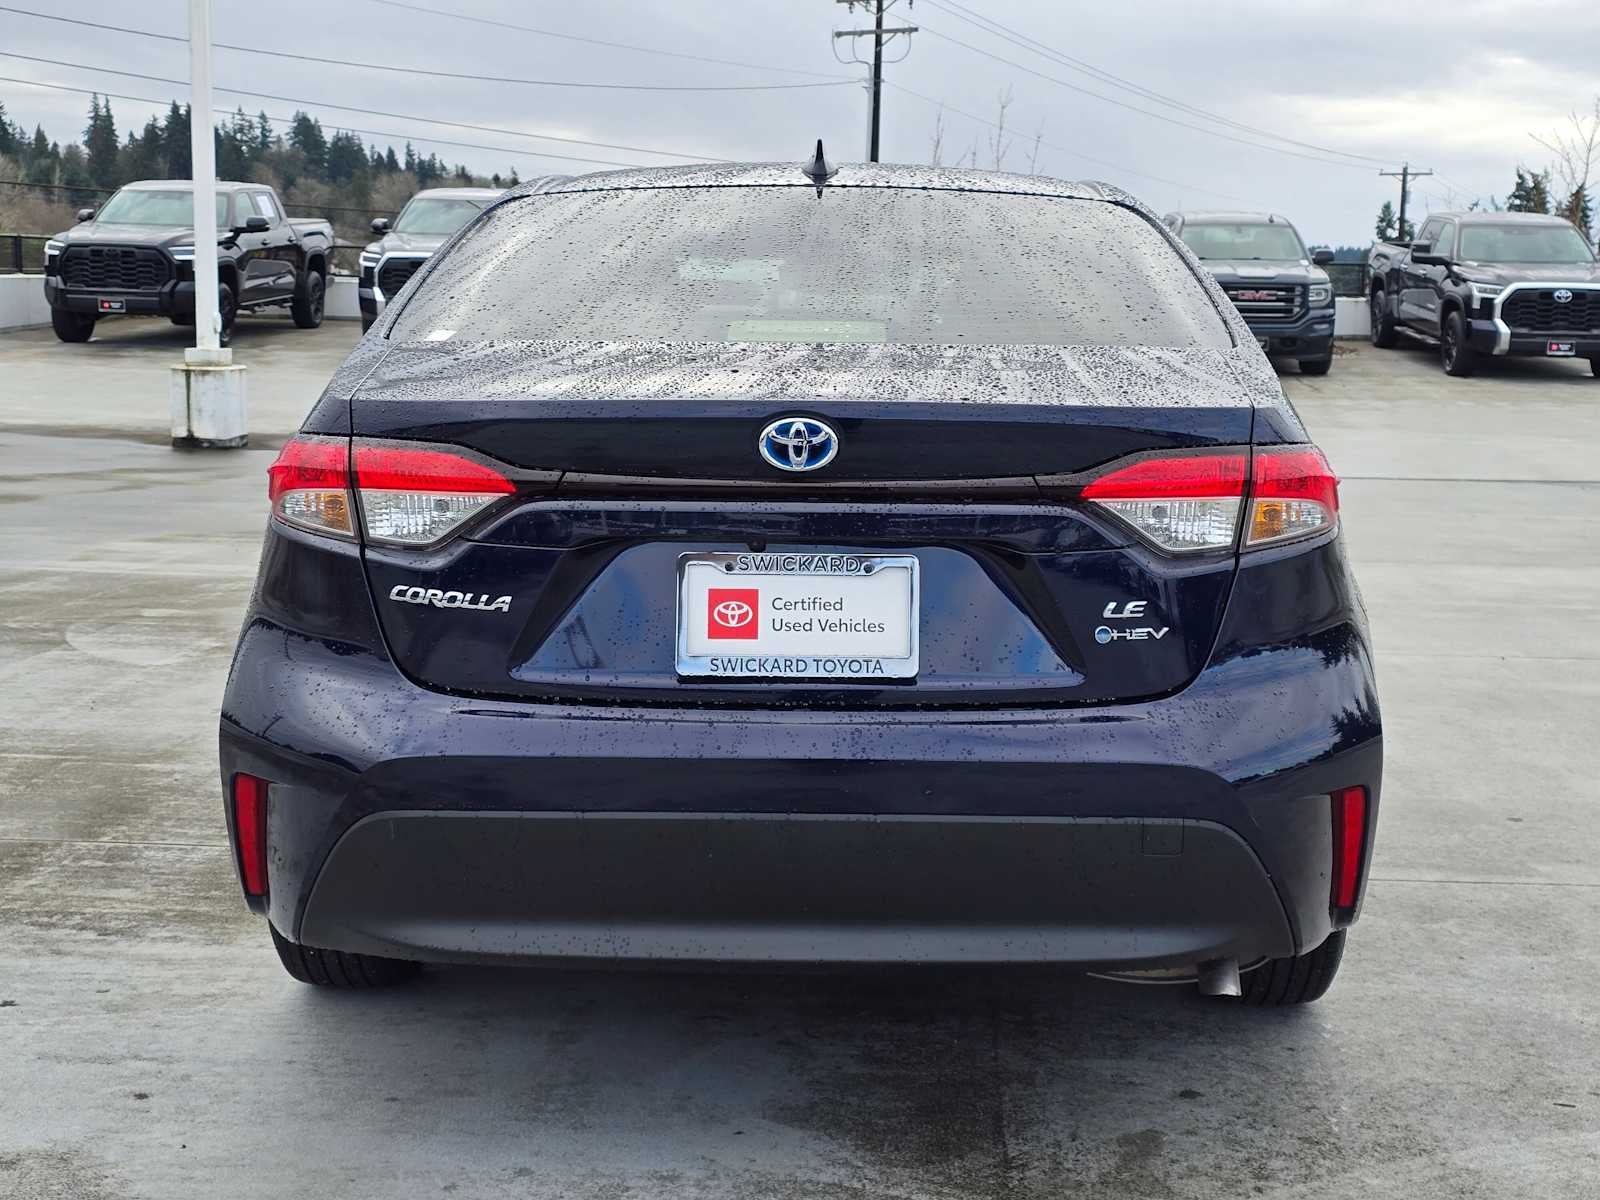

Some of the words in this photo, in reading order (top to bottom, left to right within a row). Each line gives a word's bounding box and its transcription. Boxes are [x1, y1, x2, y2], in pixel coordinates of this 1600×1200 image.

[1238, 290, 1277, 301] GMC
[738, 556, 861, 574] SWICKARD
[389, 585, 513, 612] COROLLA
[772, 597, 843, 612] Certified
[1103, 601, 1148, 618] LE
[772, 619, 813, 633] Used
[818, 618, 885, 633] Vehicles
[1111, 627, 1170, 641] HEV
[710, 658, 807, 674] SWICKARD
[813, 659, 884, 674] TOYOTA
